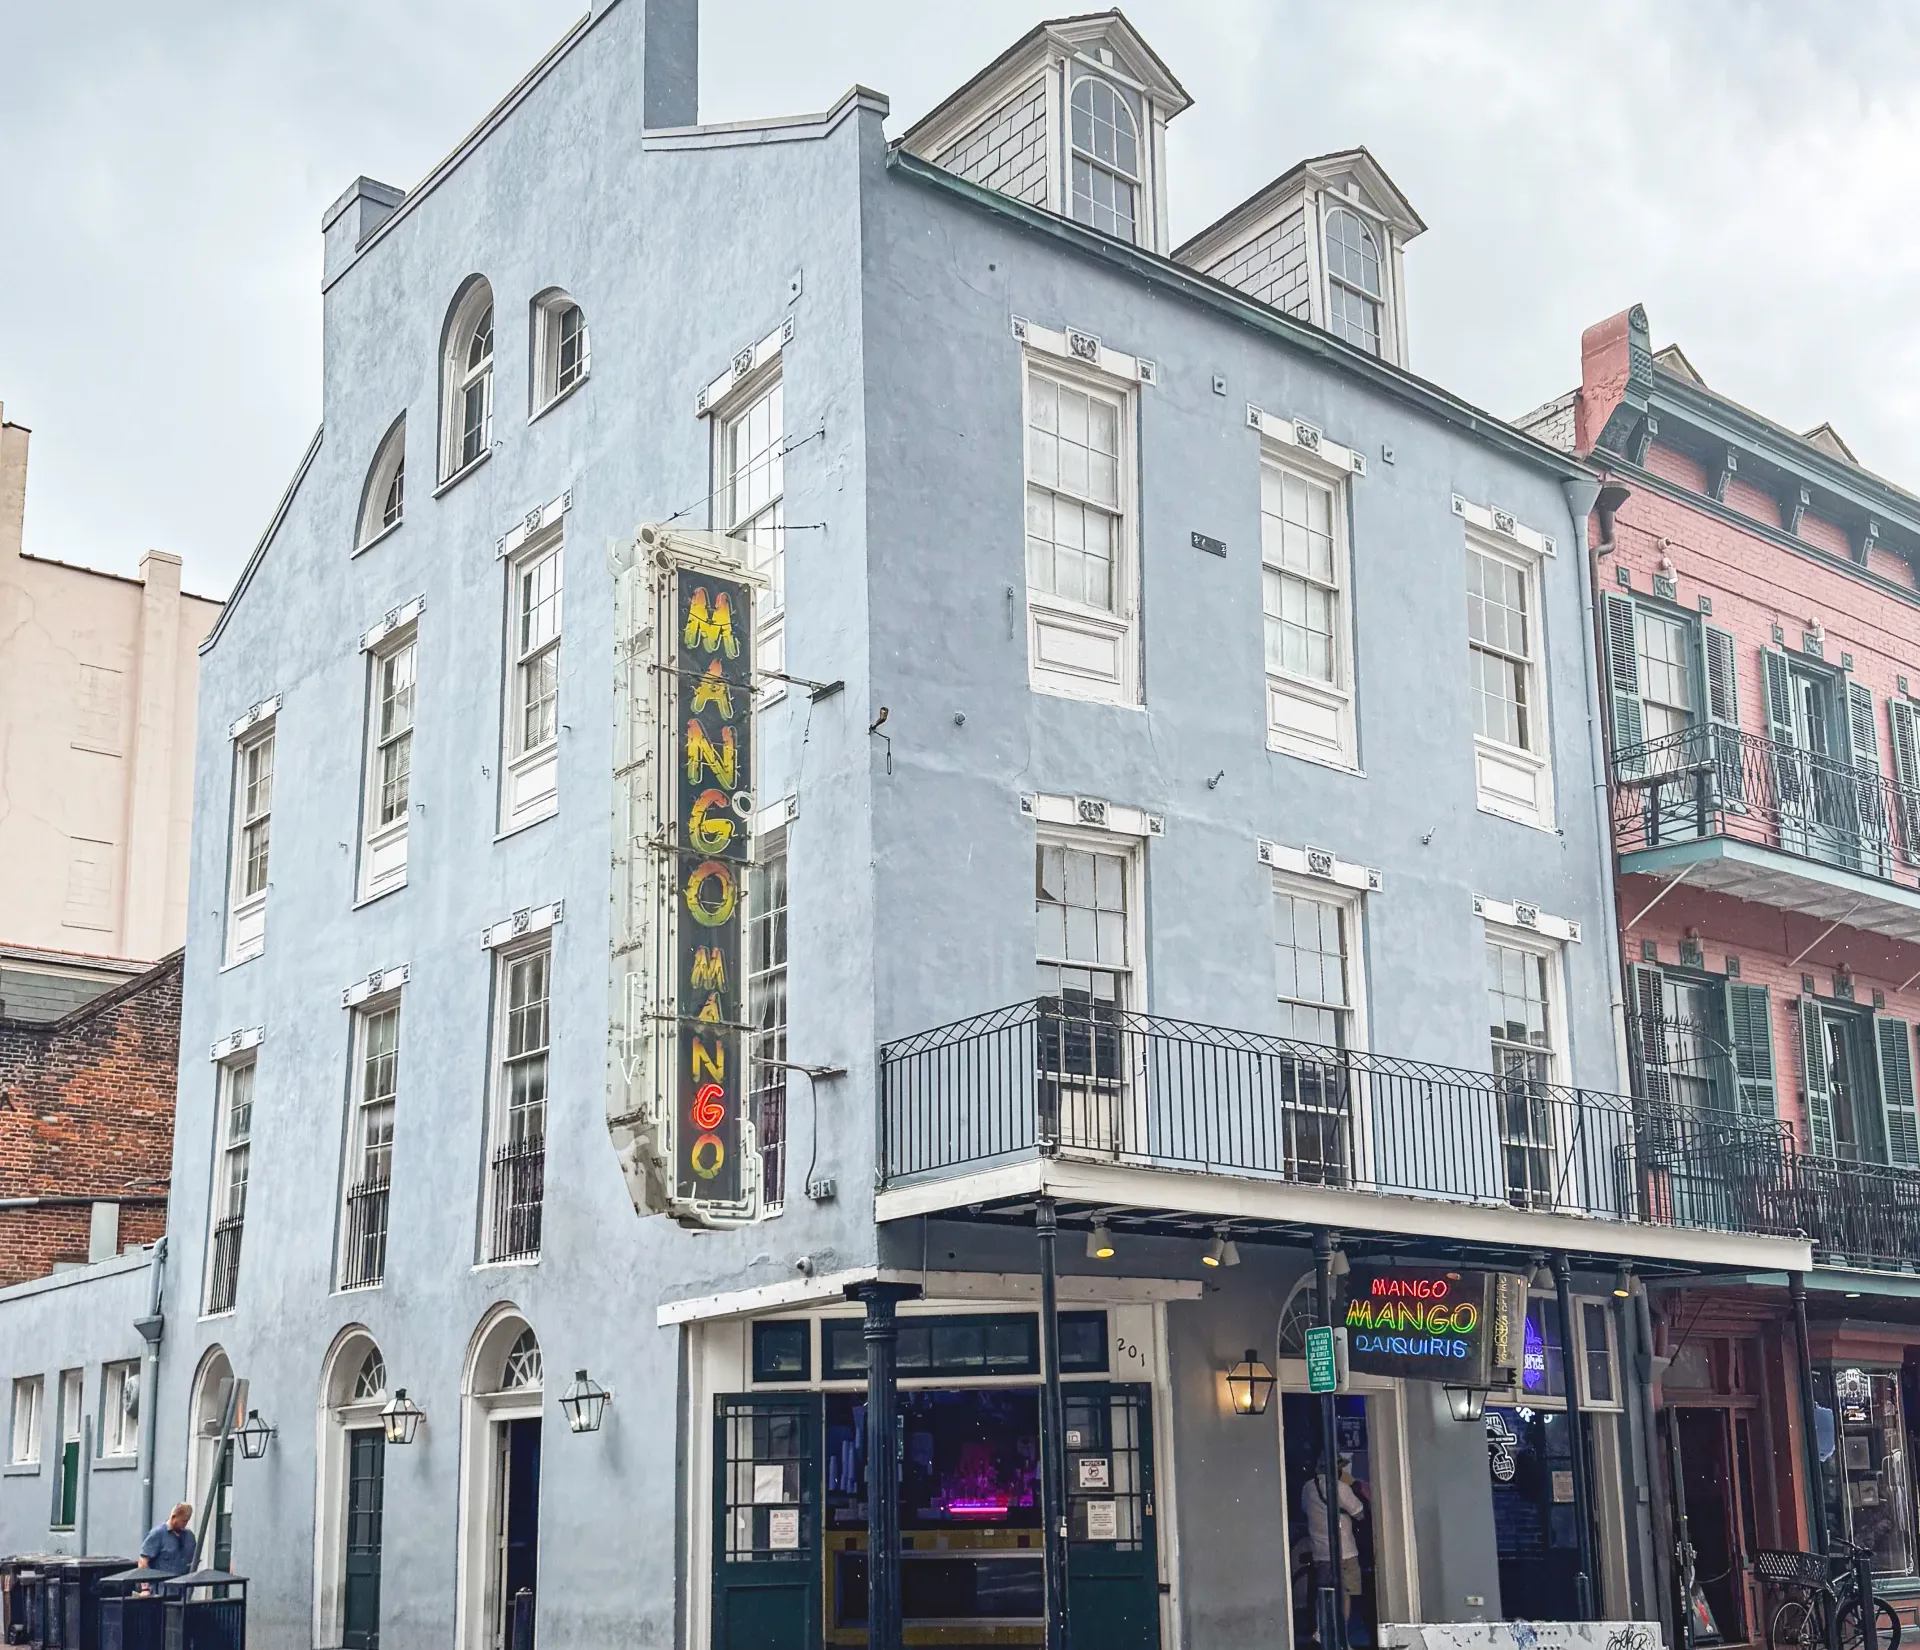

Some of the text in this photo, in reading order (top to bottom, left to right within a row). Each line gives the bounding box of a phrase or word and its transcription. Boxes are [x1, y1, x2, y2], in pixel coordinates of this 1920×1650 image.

[684, 587, 740, 1180] MANGO MANGO
[1371, 1279, 1448, 1298] MANGO
[1346, 1299, 1478, 1334] MANGO
[1117, 1337, 1145, 1367] 201
[1356, 1335, 1468, 1358] DAIQUIRIS
